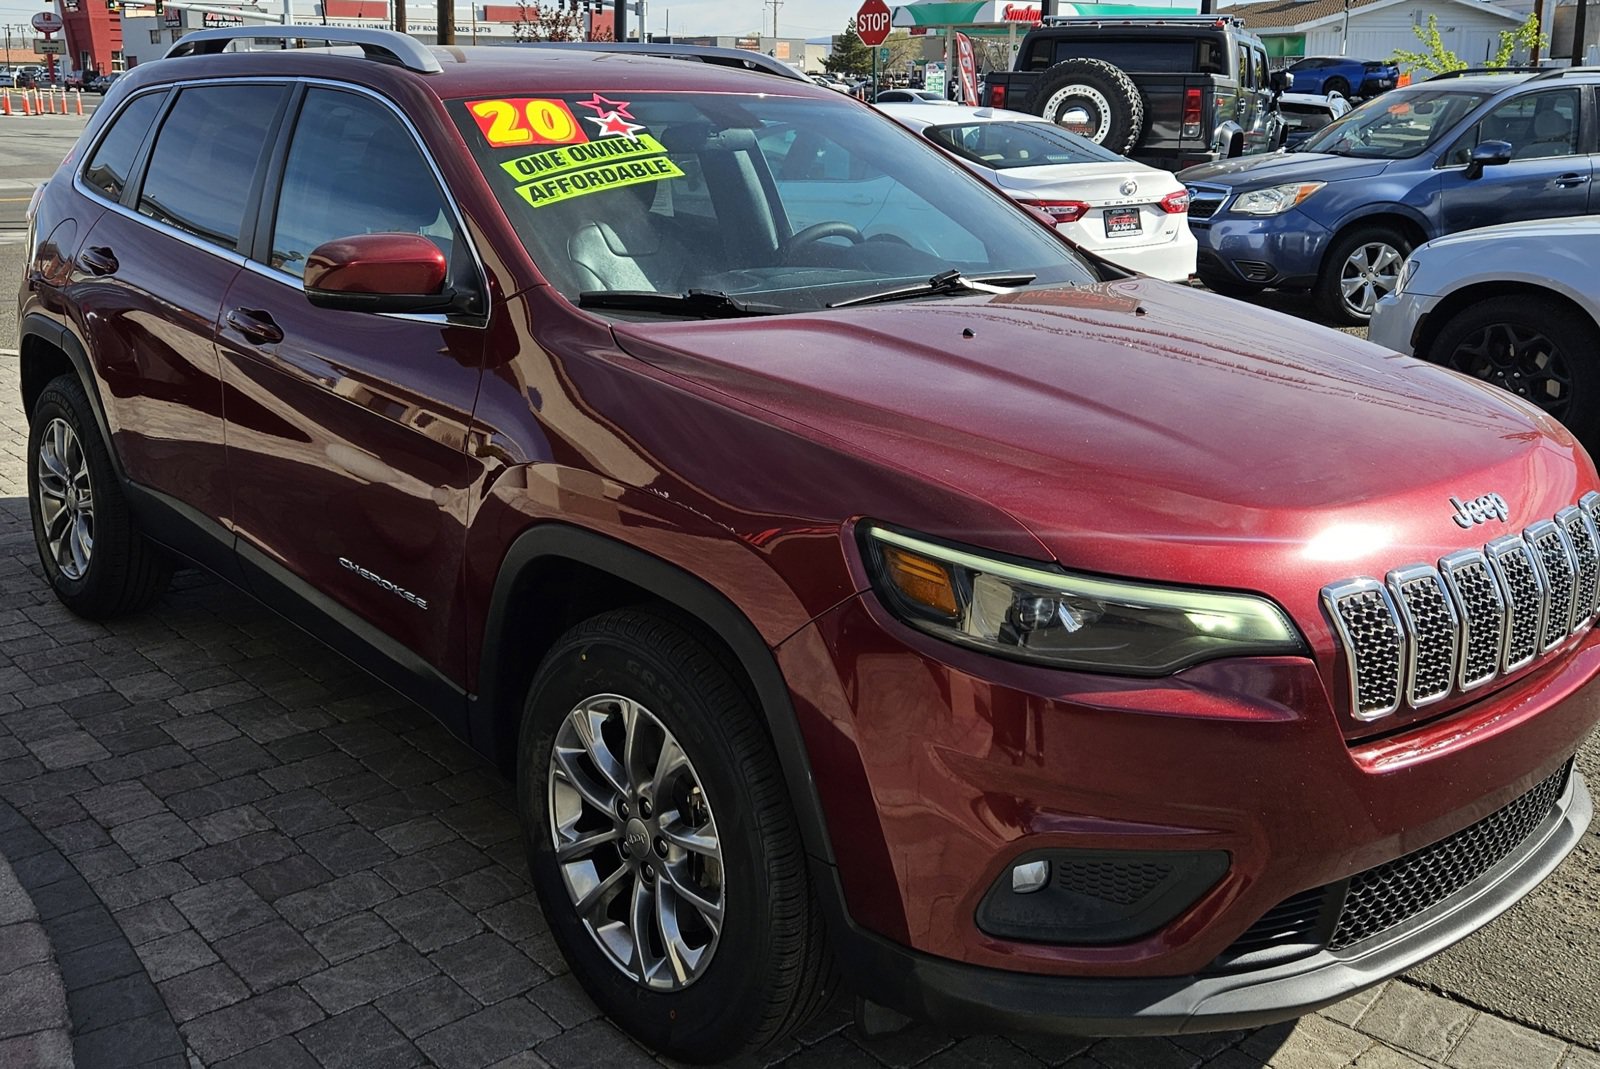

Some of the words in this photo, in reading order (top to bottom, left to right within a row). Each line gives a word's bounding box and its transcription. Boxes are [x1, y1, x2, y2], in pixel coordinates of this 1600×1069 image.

[859, 13, 889, 32] STOP
[473, 100, 575, 143] 20
[515, 151, 567, 176] ONE
[567, 137, 649, 162] OWNER
[529, 159, 672, 202] AFFORDABLE
[1449, 492, 1509, 529] Jeep
[339, 557, 428, 610] CHEROKEE
